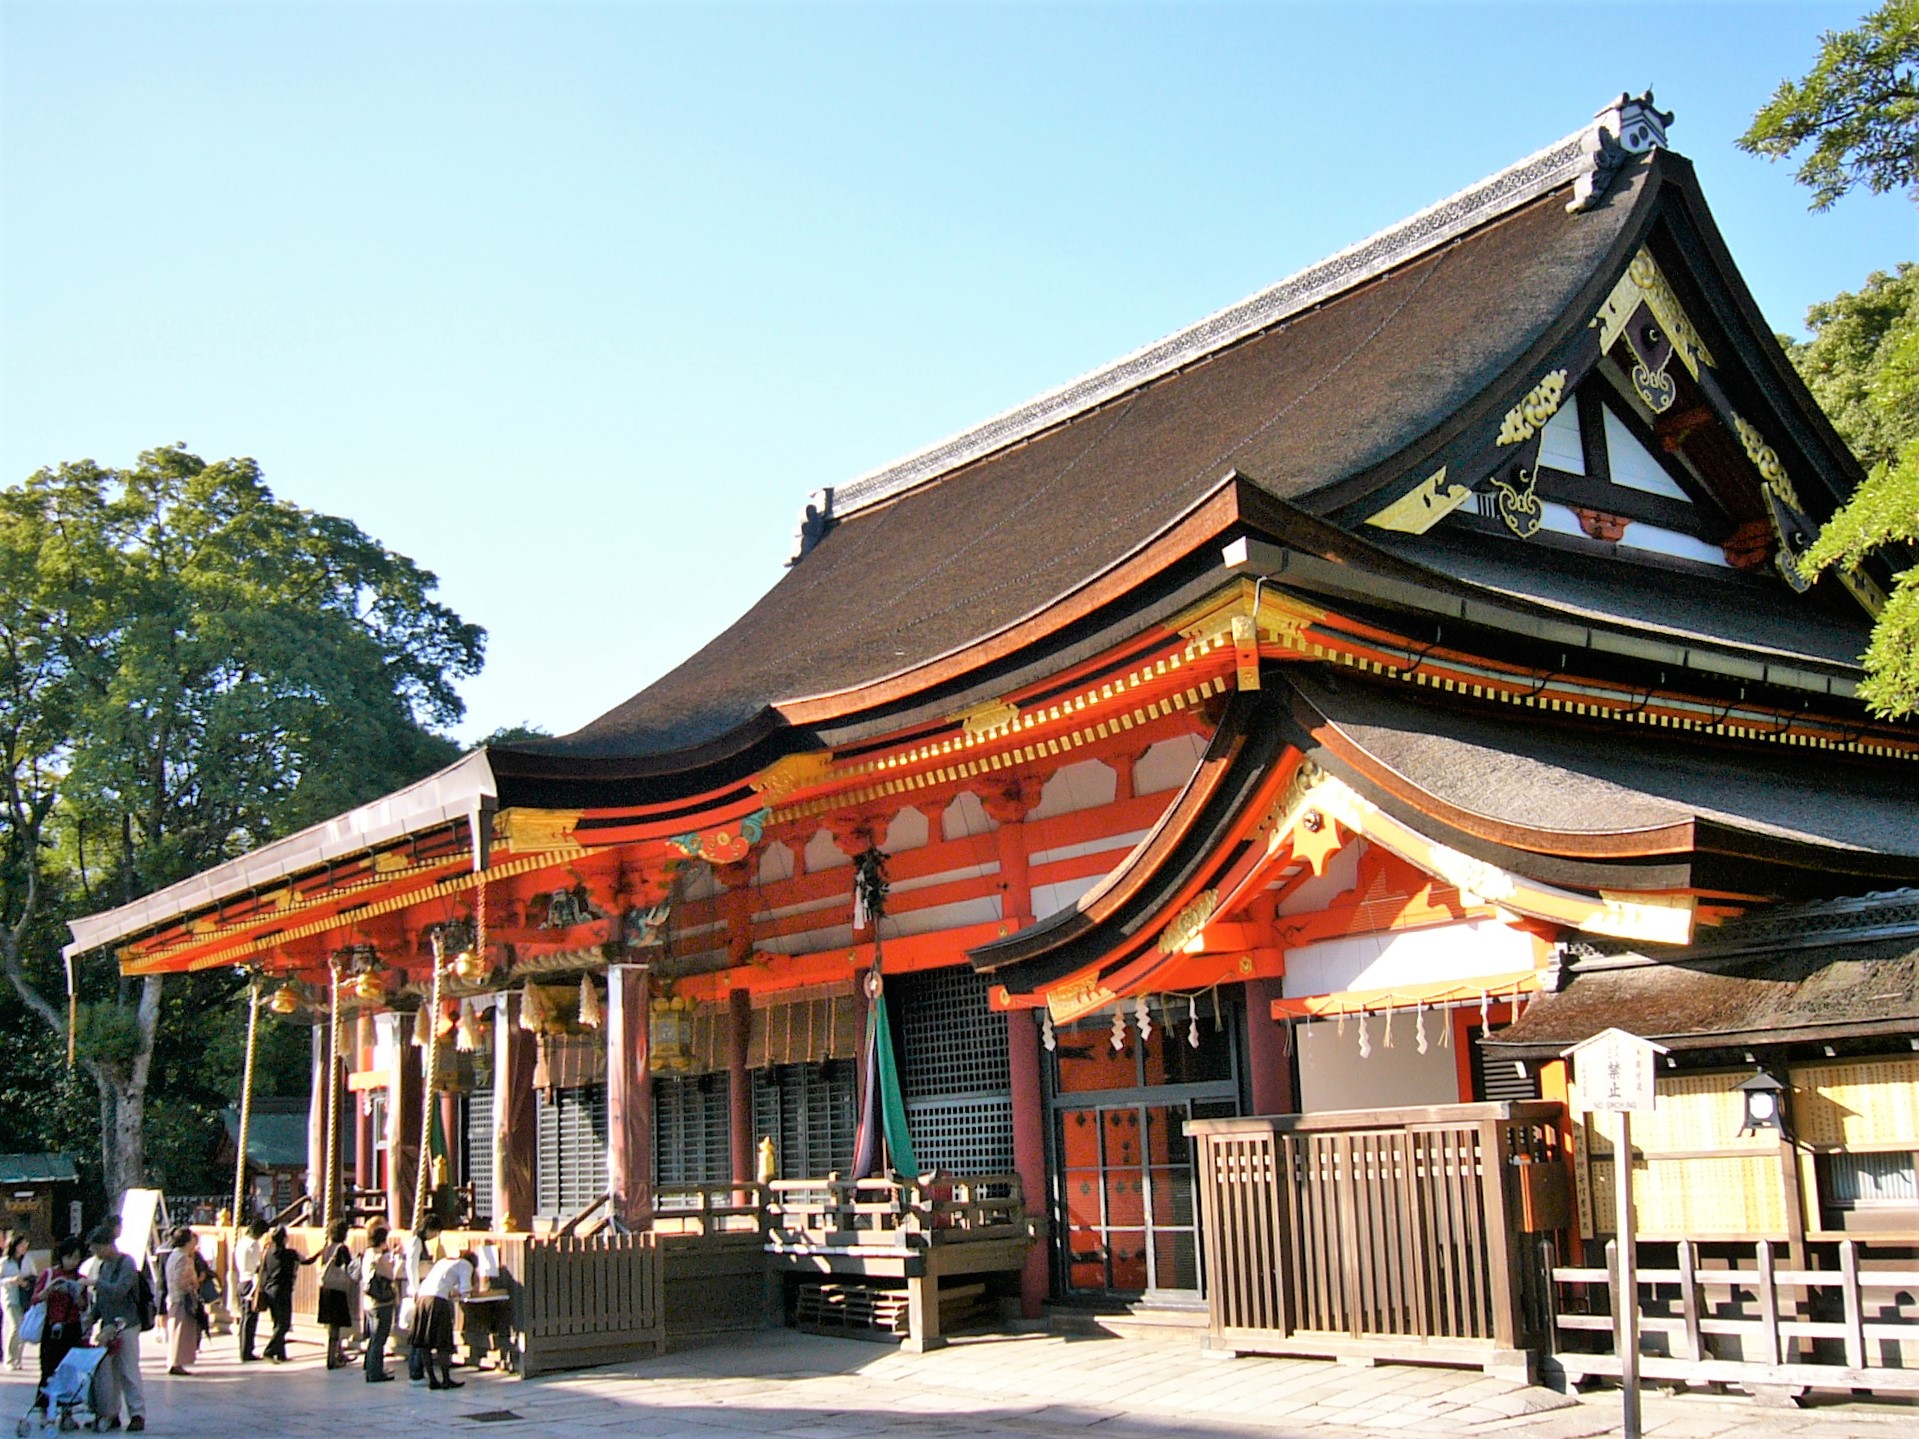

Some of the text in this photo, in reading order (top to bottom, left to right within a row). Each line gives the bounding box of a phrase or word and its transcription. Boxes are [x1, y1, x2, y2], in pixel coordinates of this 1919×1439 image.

[1608, 1061, 1622, 1098] 禁止
[1593, 1101, 1637, 1109] NO SMOKING
